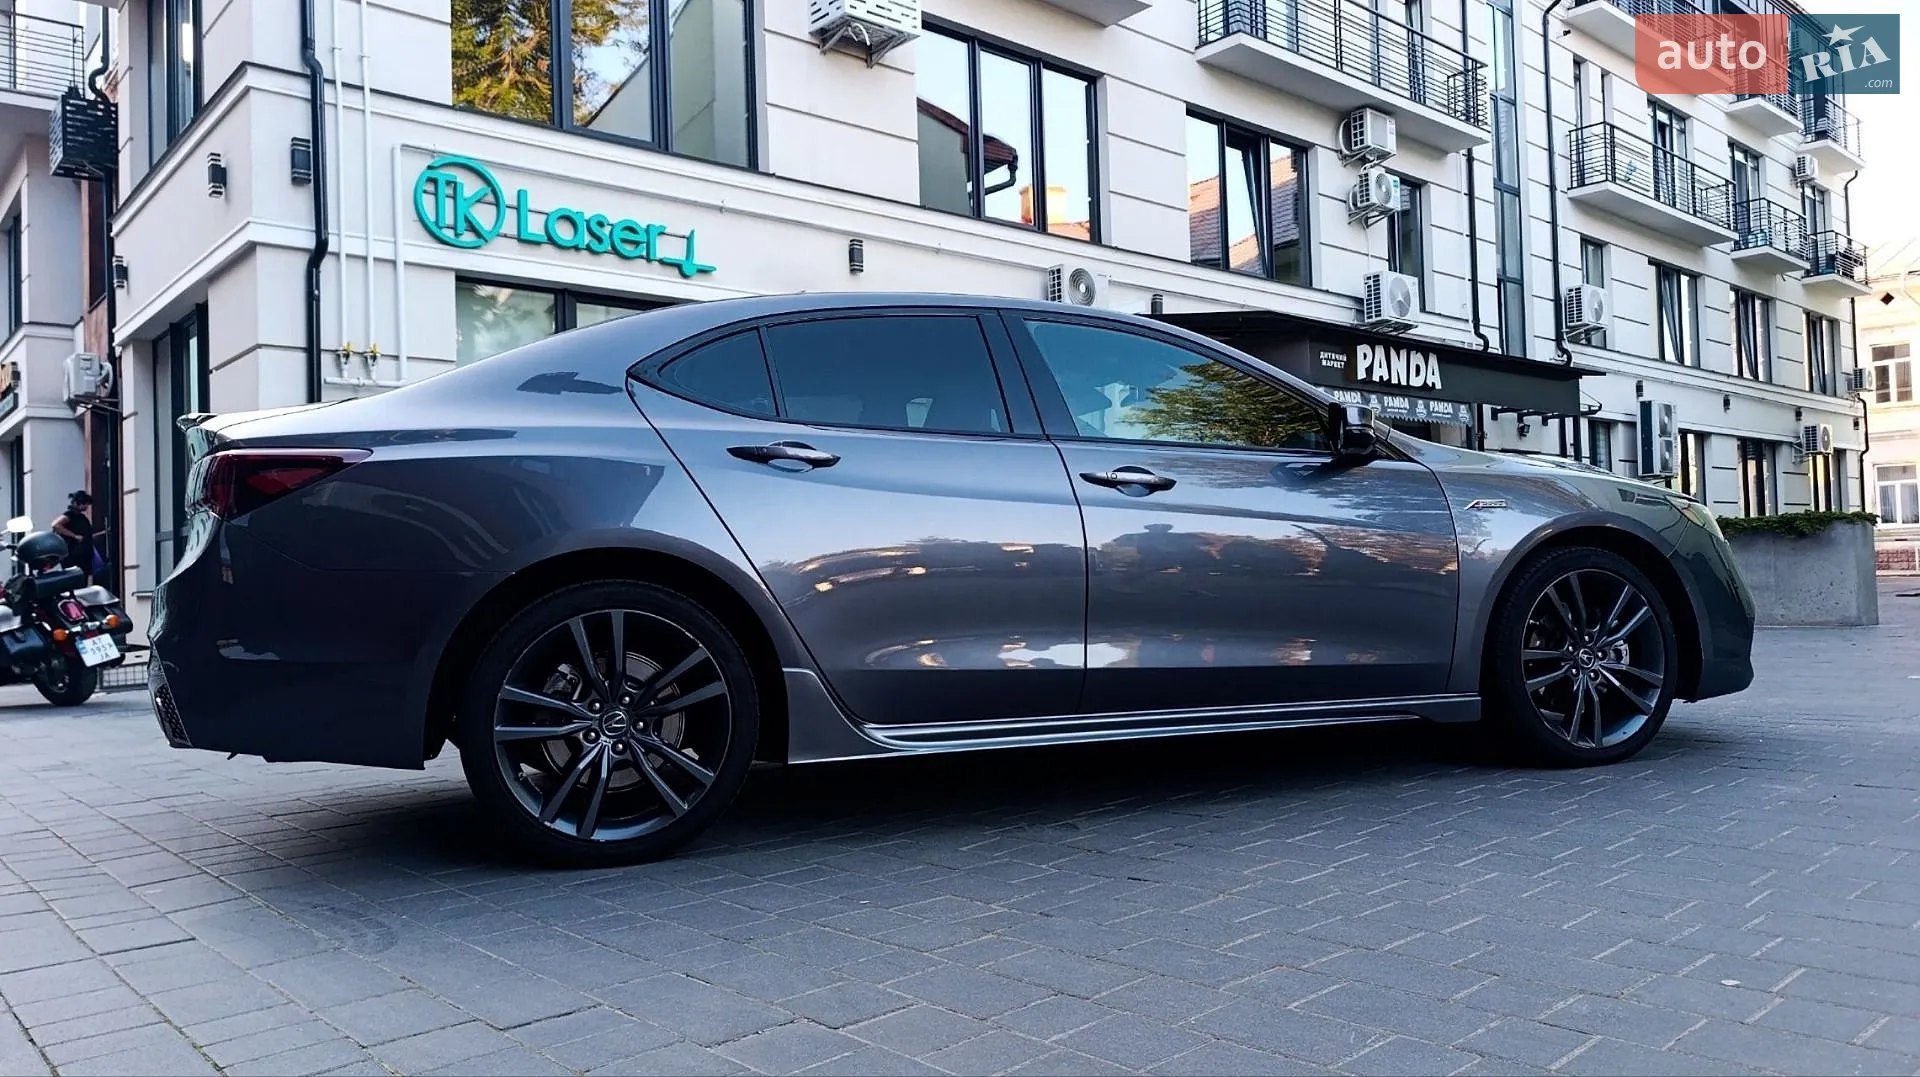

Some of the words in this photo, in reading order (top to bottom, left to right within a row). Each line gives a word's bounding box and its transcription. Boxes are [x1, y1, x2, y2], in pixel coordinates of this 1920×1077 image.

[517, 189, 666, 262] Laser
[1321, 359, 1345, 369] МАРКЕТ
[1356, 344, 1442, 390] PANDA
[1334, 391, 1361, 404] PANDA
[1384, 396, 1409, 409] PANDA
[1429, 401, 1453, 414] PANDA
